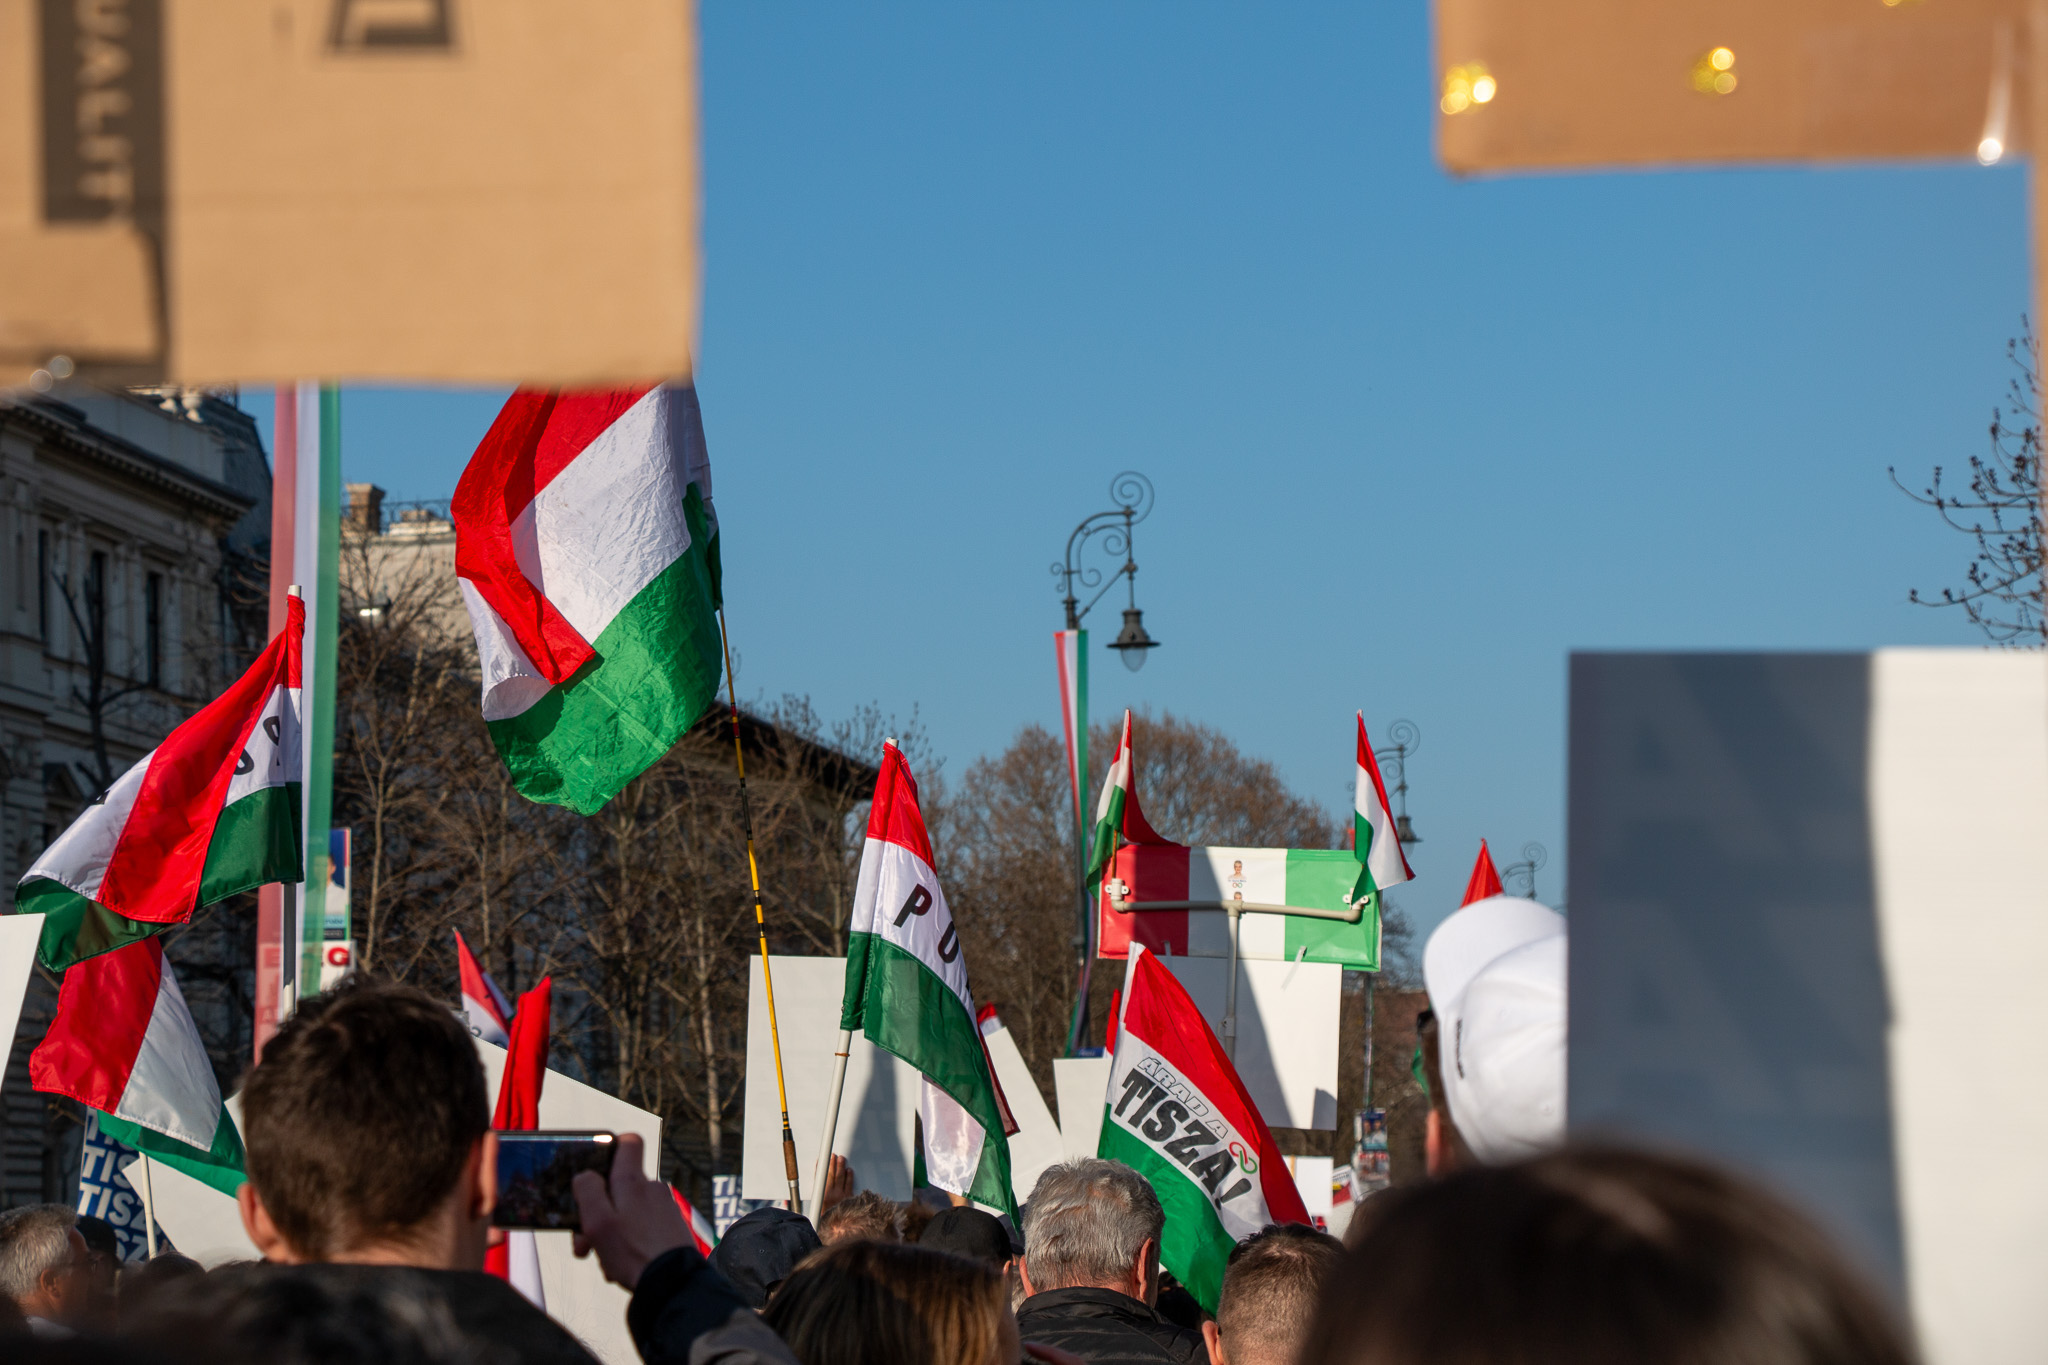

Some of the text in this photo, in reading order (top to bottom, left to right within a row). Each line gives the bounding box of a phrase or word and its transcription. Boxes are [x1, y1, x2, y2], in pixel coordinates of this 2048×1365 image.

[1114, 1068, 1252, 1210] TISZA!
[1137, 1057, 1228, 1139] ÁRAD A
[713, 1176, 742, 1196] TI
